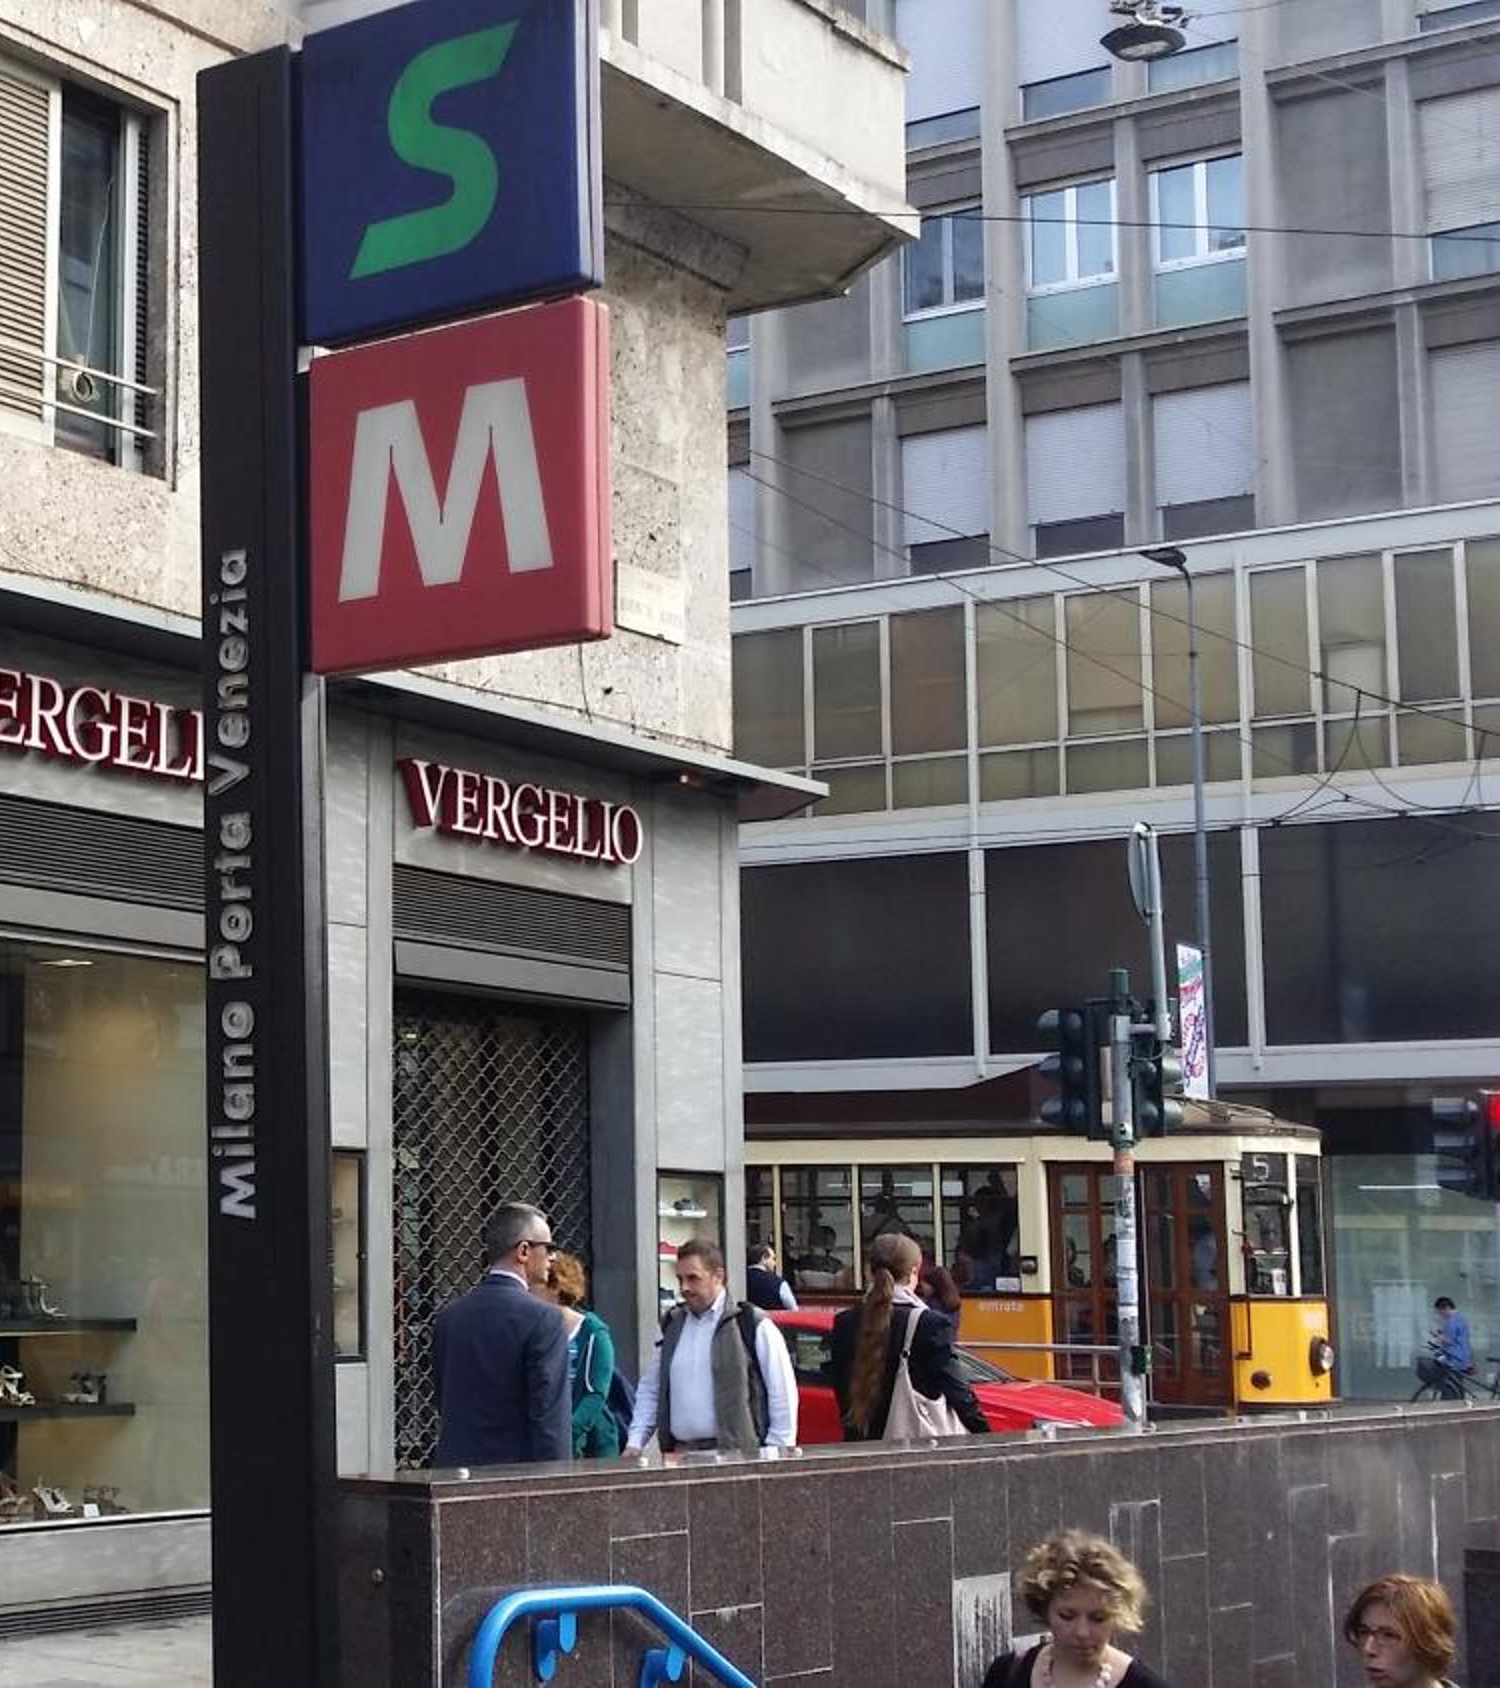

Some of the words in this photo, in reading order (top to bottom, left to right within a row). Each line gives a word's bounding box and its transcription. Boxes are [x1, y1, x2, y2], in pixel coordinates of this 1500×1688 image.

[348, 19, 521, 281] S
[337, 376, 555, 603] M
[206, 548, 251, 797] Venezia
[209, 812, 253, 979] Porta
[404, 758, 643, 865] VERGELIO
[210, 999, 257, 1220] Milano
[1252, 1154, 1270, 1181] 5
